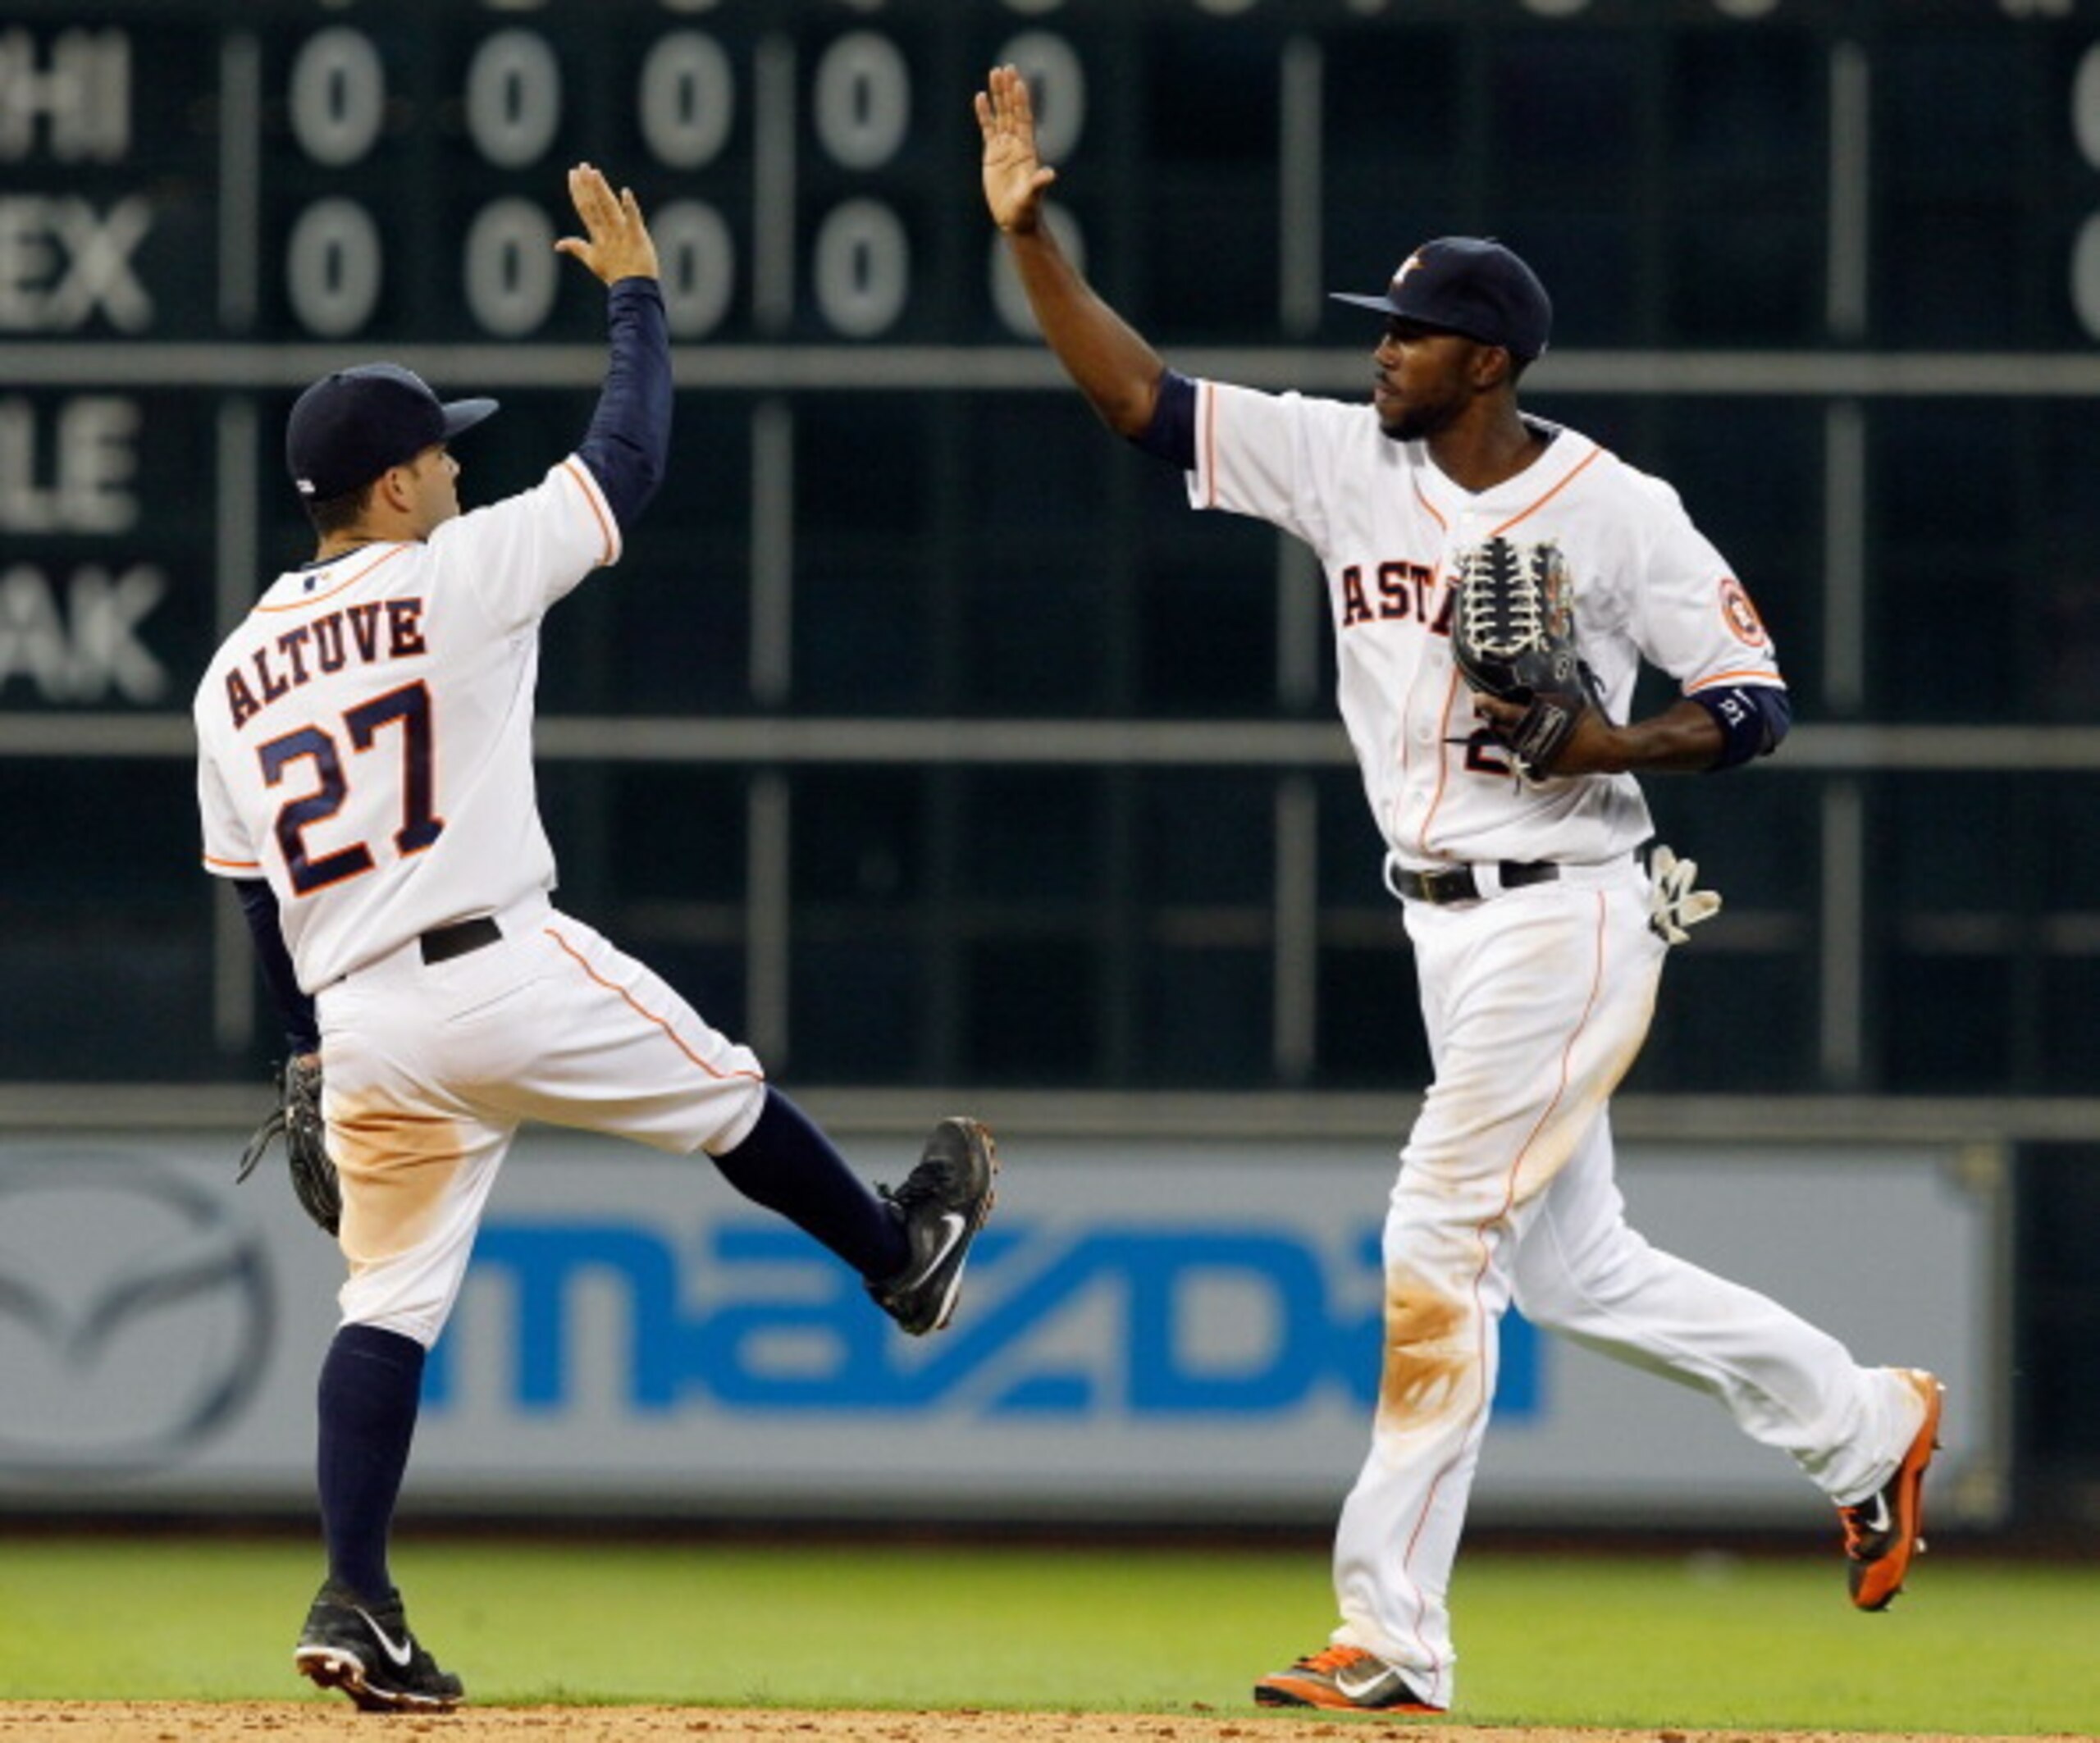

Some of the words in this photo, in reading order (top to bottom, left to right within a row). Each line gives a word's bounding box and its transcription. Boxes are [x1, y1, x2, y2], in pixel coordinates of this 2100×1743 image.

[0, 31, 130, 159] HI
[290, 28, 384, 164] 0
[467, 30, 560, 166] 0
[640, 31, 733, 167] 0
[815, 33, 909, 169] 0
[0, 194, 153, 331] EX
[287, 198, 380, 333] 0
[464, 198, 558, 333] 0
[651, 200, 733, 336] 0
[815, 200, 908, 335] 0
[0, 395, 138, 535] LE
[225, 596, 427, 730] ALTUVE
[256, 678, 446, 898] 27
